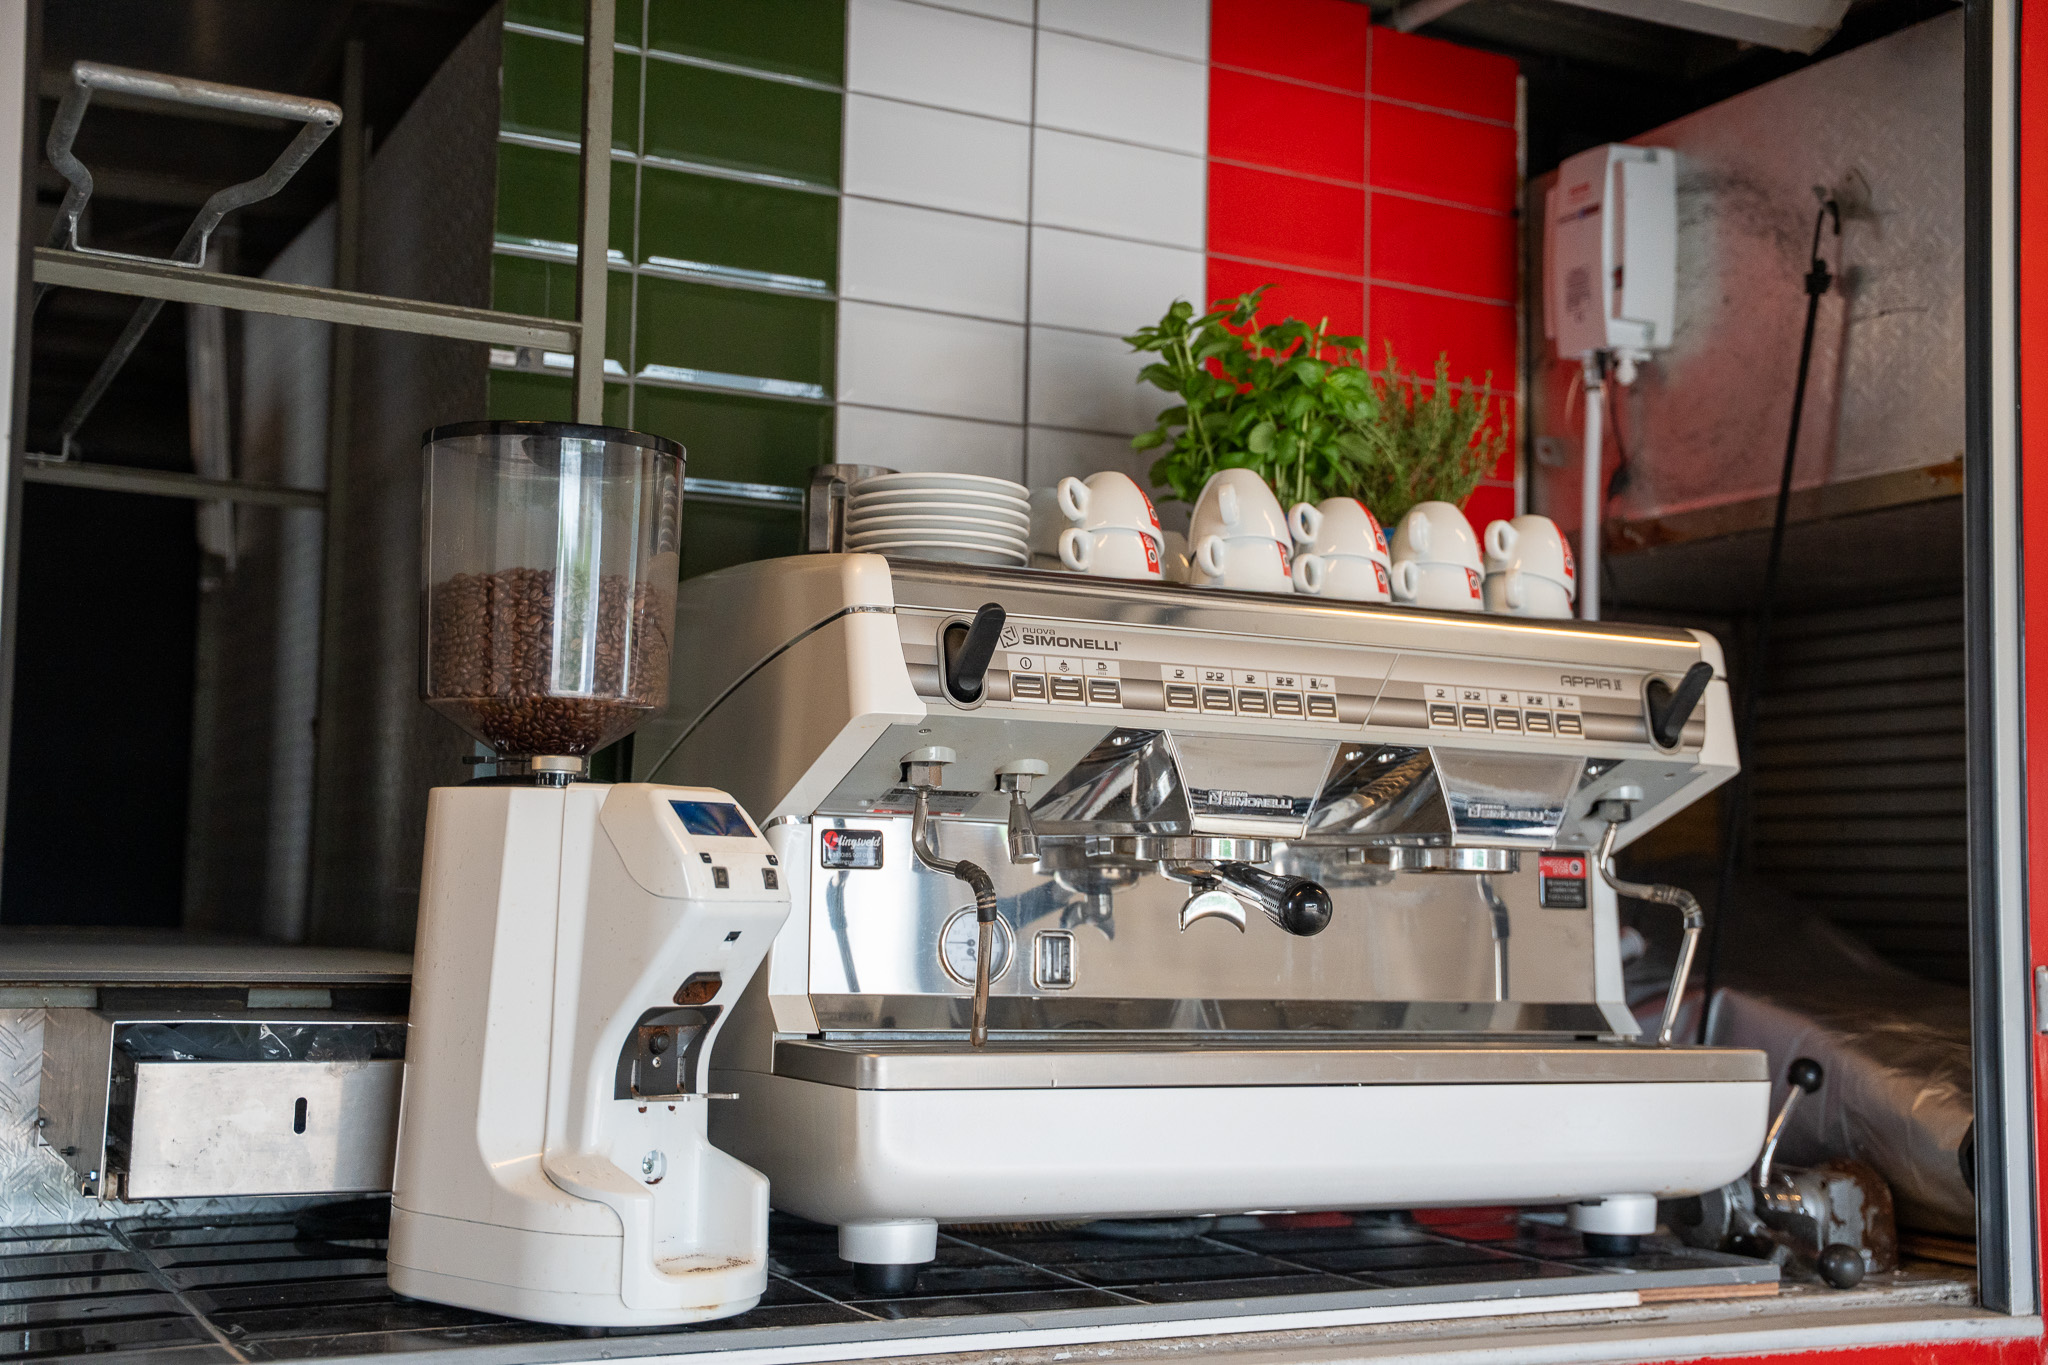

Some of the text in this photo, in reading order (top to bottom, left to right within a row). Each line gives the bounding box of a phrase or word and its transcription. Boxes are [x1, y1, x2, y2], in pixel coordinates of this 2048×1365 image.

[1022, 626, 1056, 635] nuova
[1022, 634, 1119, 652] SIMONELLI
[1561, 675, 1611, 690] APPIA
[1222, 796, 1293, 809] SIMONELLI
